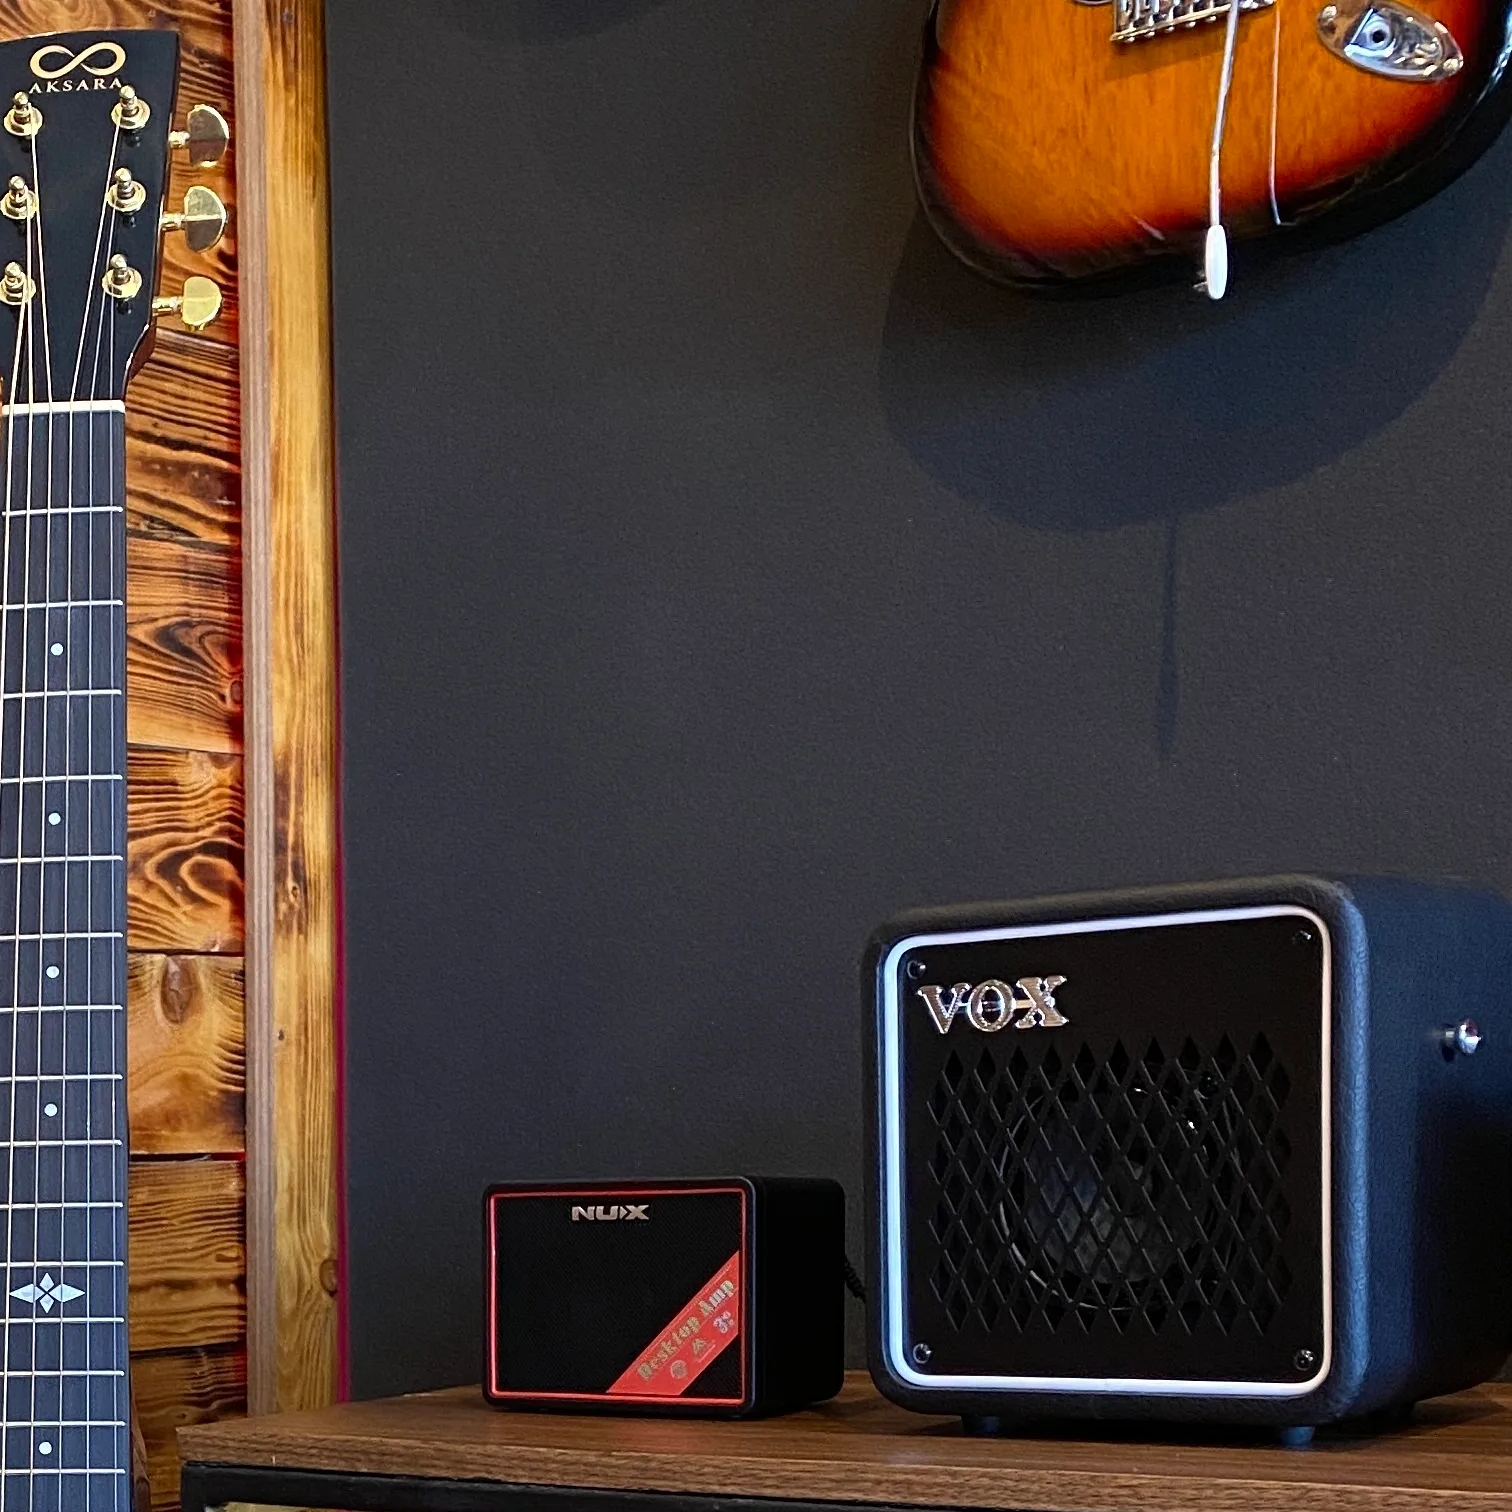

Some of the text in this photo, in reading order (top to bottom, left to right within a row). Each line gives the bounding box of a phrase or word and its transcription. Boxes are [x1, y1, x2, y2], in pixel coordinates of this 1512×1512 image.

[28, 77, 122, 94] AKSARA
[916, 975, 1069, 1034] VOX
[571, 1204, 650, 1221] NUX
[637, 1280, 735, 1382] Desktop Amp
